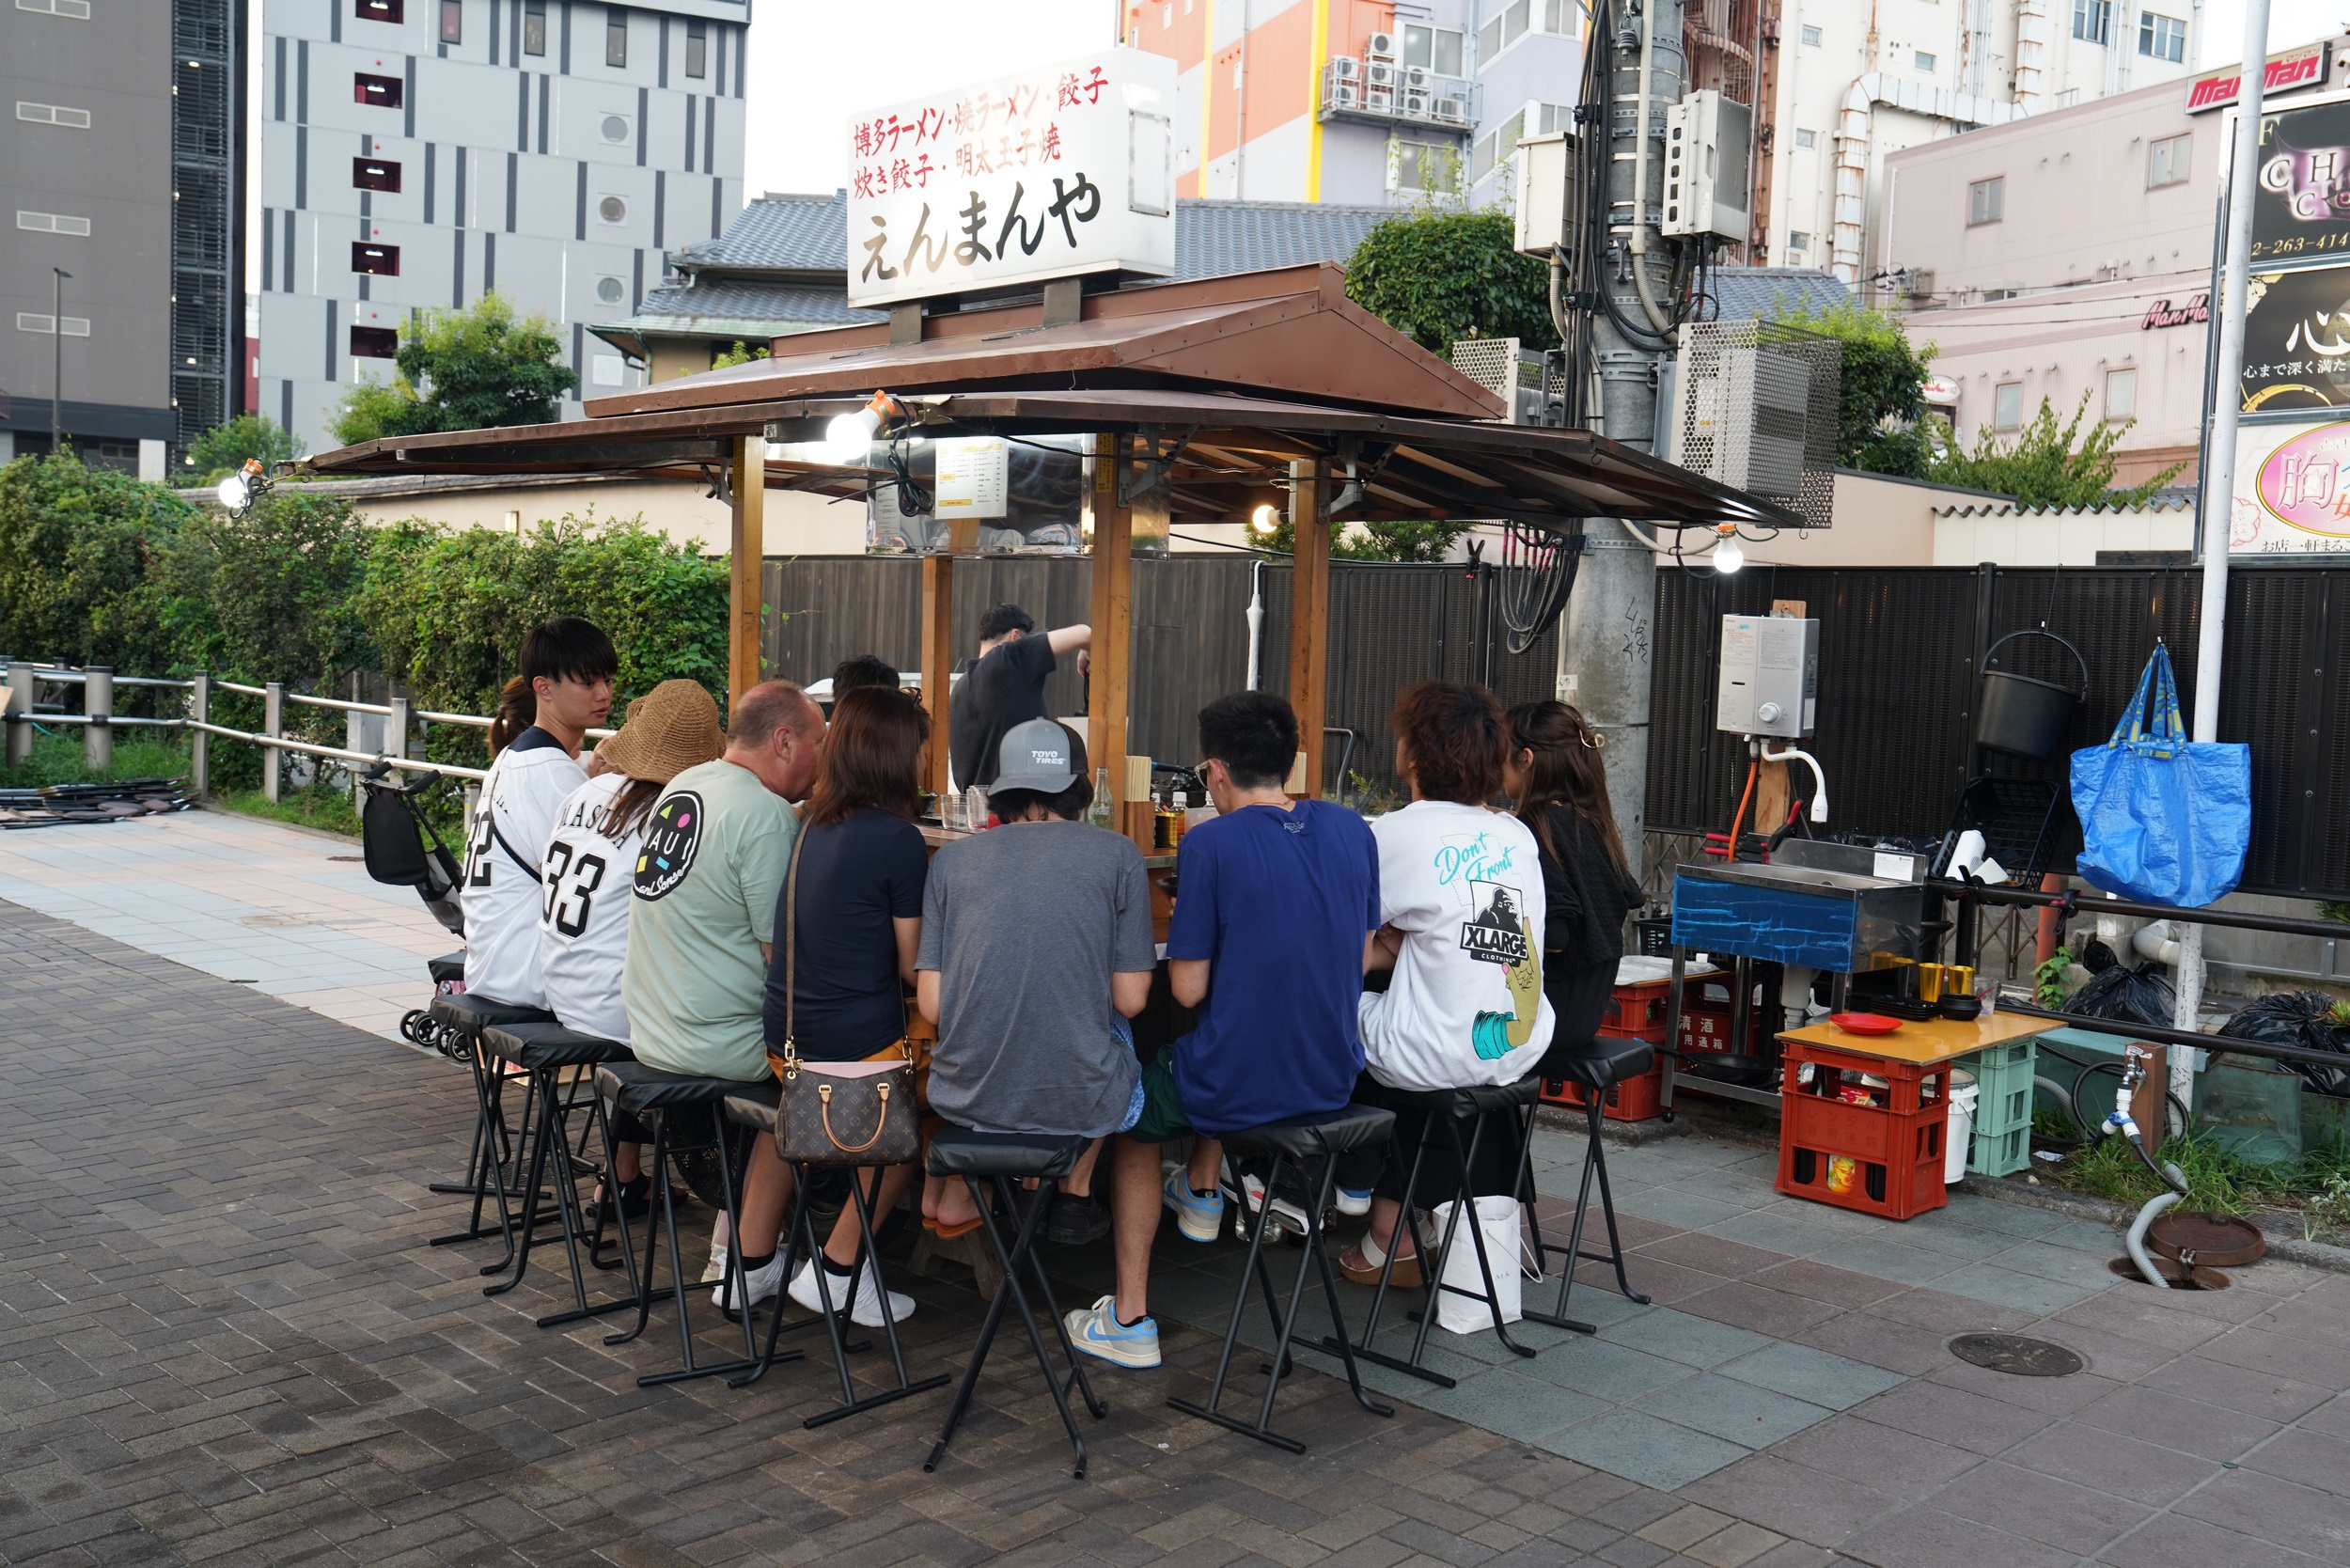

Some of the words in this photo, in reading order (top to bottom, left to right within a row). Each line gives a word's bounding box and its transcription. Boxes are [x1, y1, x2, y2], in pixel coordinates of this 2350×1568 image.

[862, 172, 1101, 284] えんまんや
[2243, 358, 2347, 379] 心まで深く満た
[2275, 450, 2340, 511] 胸
[1035, 757, 1065, 765] TIRES
[1434, 832, 1490, 886] Don't
[1465, 846, 1517, 882] Front
[541, 839, 607, 939] 33
[1465, 926, 1528, 957] XLARGE
[1481, 952, 1512, 964] CLOTHING
[1679, 1014, 1714, 1033] 清酒
[1806, 1105, 1879, 1131] レンタル
